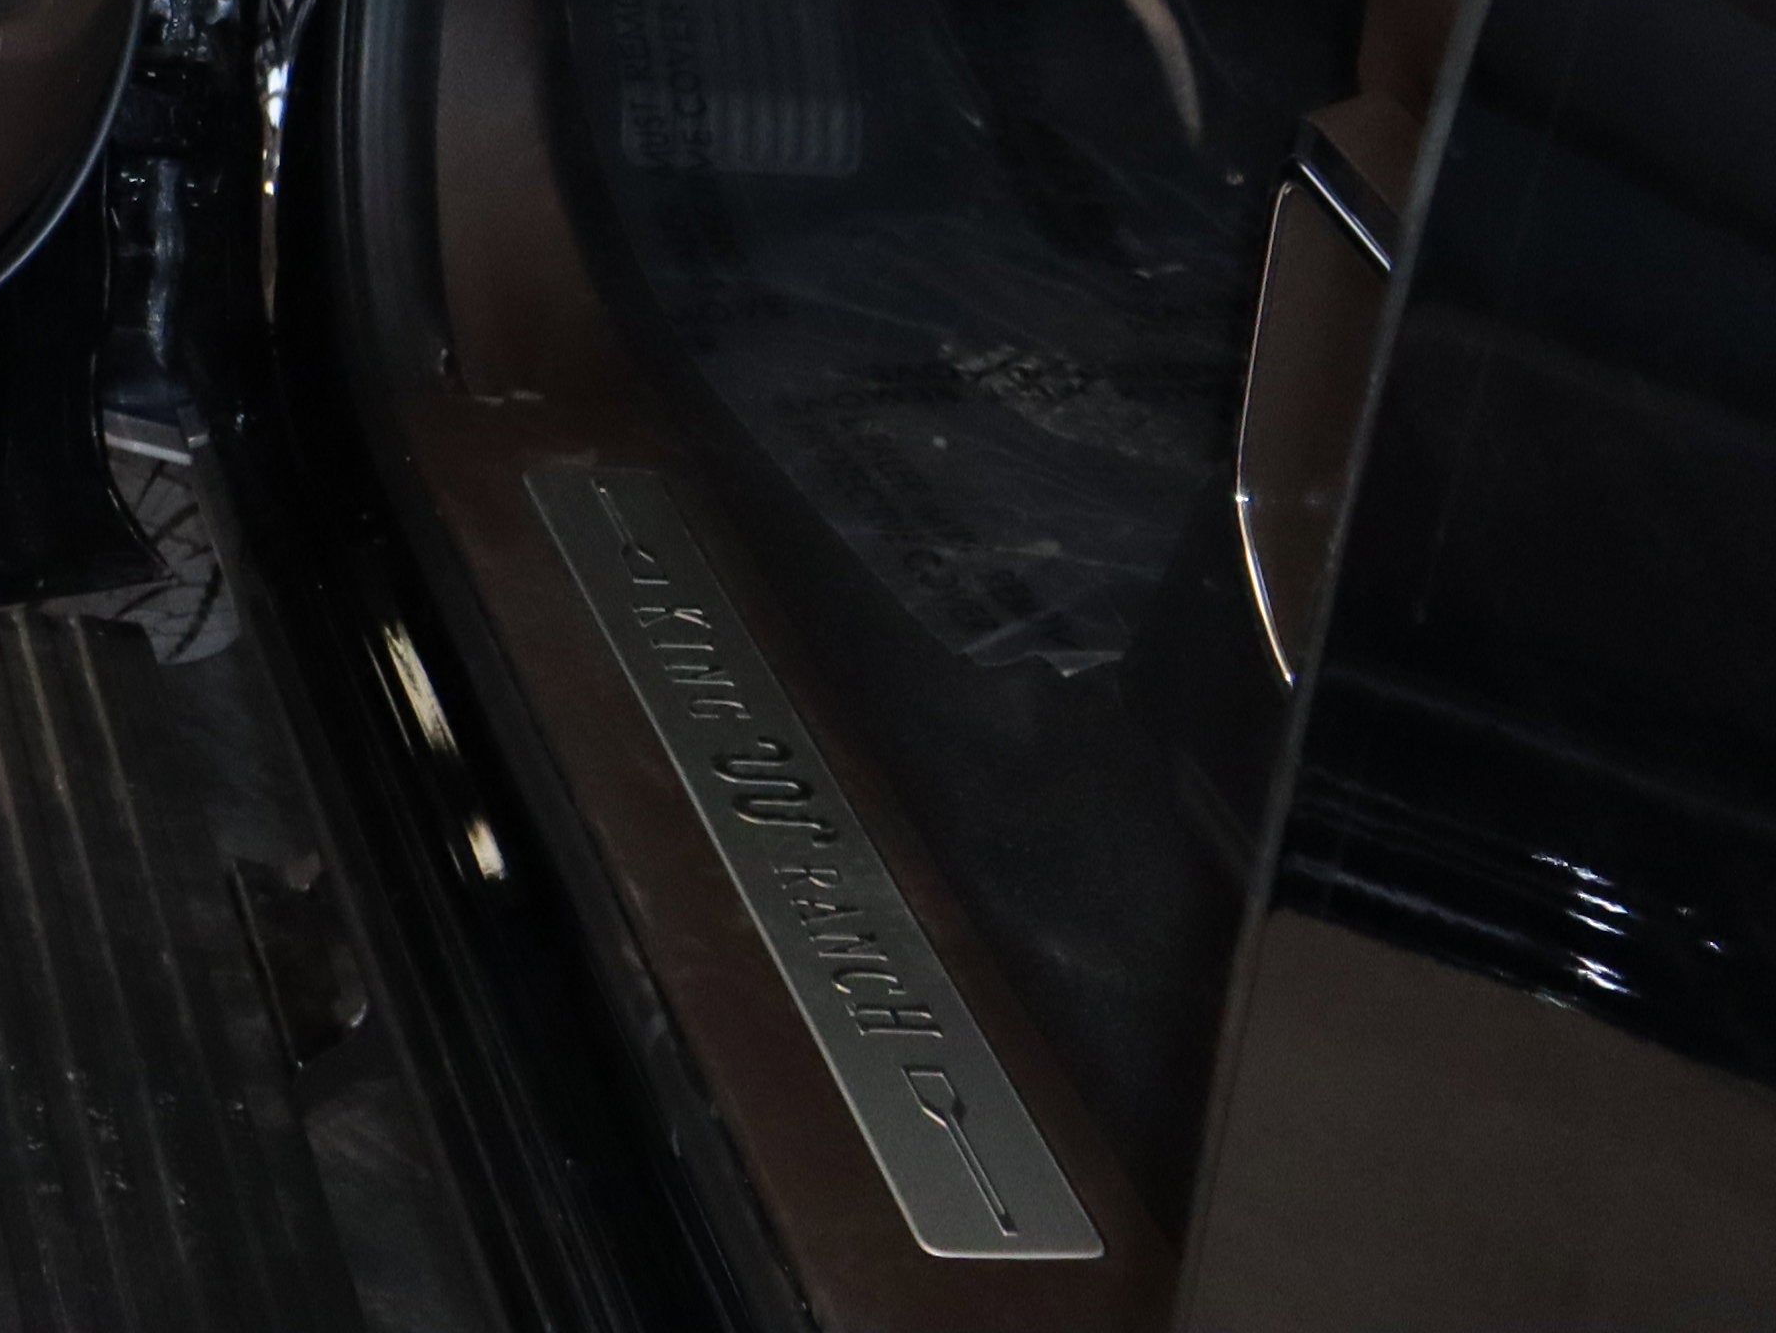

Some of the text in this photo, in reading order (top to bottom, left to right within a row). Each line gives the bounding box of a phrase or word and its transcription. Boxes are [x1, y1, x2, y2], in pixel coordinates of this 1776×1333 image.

[657, 1, 707, 119] COVER
[632, 604, 944, 1039] KING RANCH
